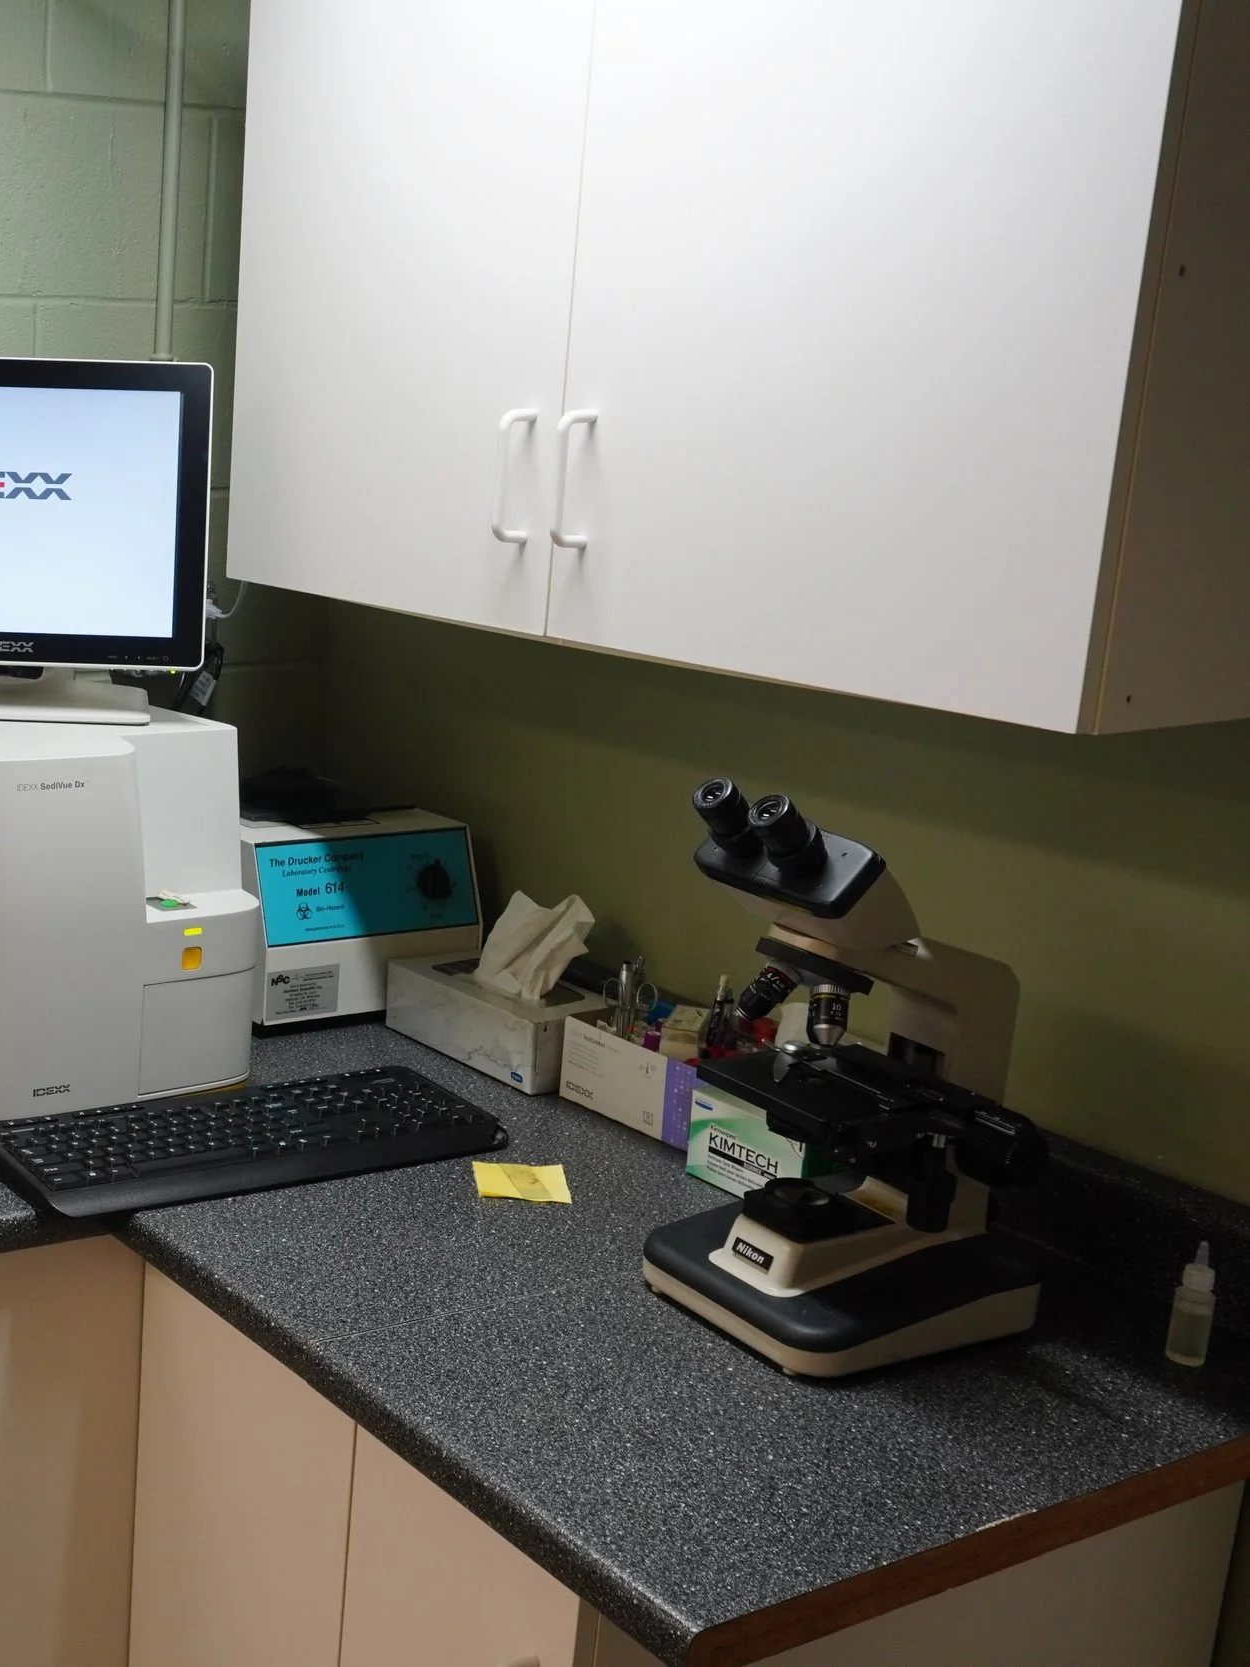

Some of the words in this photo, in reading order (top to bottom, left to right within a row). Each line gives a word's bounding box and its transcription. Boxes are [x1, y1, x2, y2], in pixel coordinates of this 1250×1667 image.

[16, 783, 39, 792] IDEXX
[40, 781, 73, 791] SediVue
[74, 780, 86, 788] Dx
[269, 858, 286, 868] The
[288, 855, 322, 866] Drucker
[324, 851, 365, 863] Company
[282, 867, 317, 877] Laboratory
[296, 886, 320, 897] Model
[325, 881, 345, 894] 614
[315, 904, 345, 913] Bio-Hazard
[271, 974, 290, 987] NSC
[832, 1003, 842, 1011] 10
[33, 1084, 70, 1097] IDEXX
[565, 1079, 595, 1100] IDEXX
[710, 1124, 736, 1141] Kimwipes
[708, 1132, 778, 1174] KIMTECH
[743, 1162, 762, 1176] SCIENCE
[736, 1242, 765, 1264] Nikon
